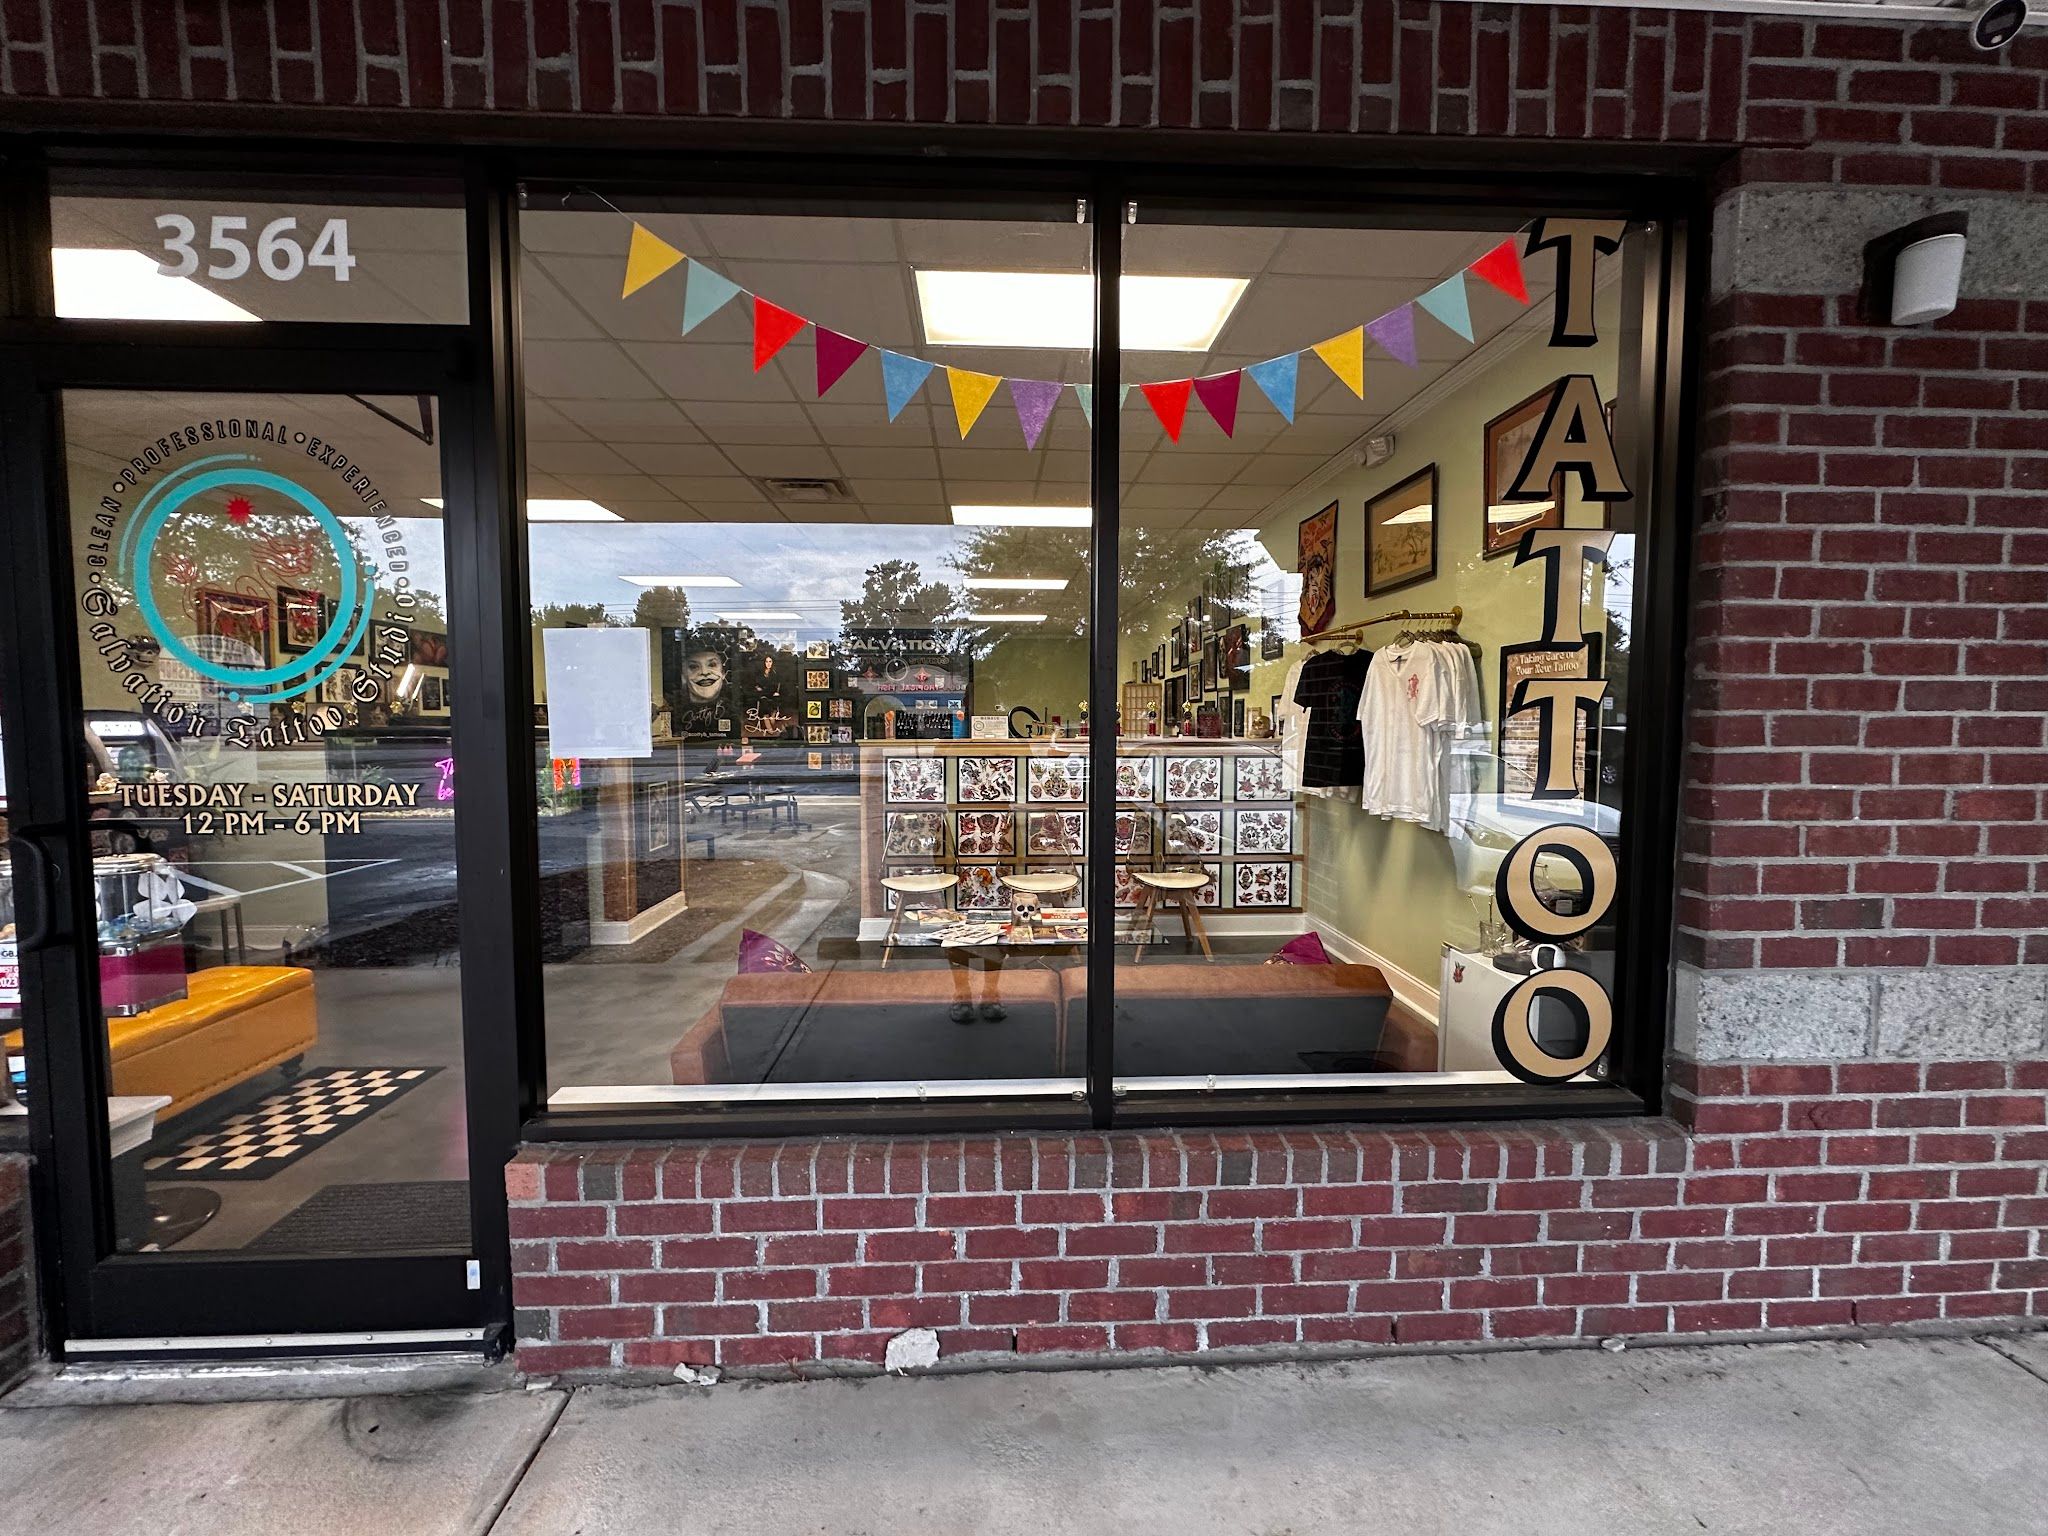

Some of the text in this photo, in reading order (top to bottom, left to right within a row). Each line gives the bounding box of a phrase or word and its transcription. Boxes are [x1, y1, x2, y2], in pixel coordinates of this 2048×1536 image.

[154, 214, 356, 282] 3564
[87, 419, 409, 572] CLEAN PROFESSIONAL EXPERIENCED
[82, 588, 416, 749] Salvation Tattoo Studio
[1492, 217, 1634, 1086] TATTOO
[1515, 661, 1579, 676] Your New Tattoo
[1519, 653, 1545, 664] Taking
[115, 783, 249, 807] TUESDAY
[271, 783, 425, 807] SATURDAY
[182, 811, 215, 835] 12
[223, 811, 267, 835] PM
[293, 811, 312, 835] 6
[319, 811, 362, 835] PM
